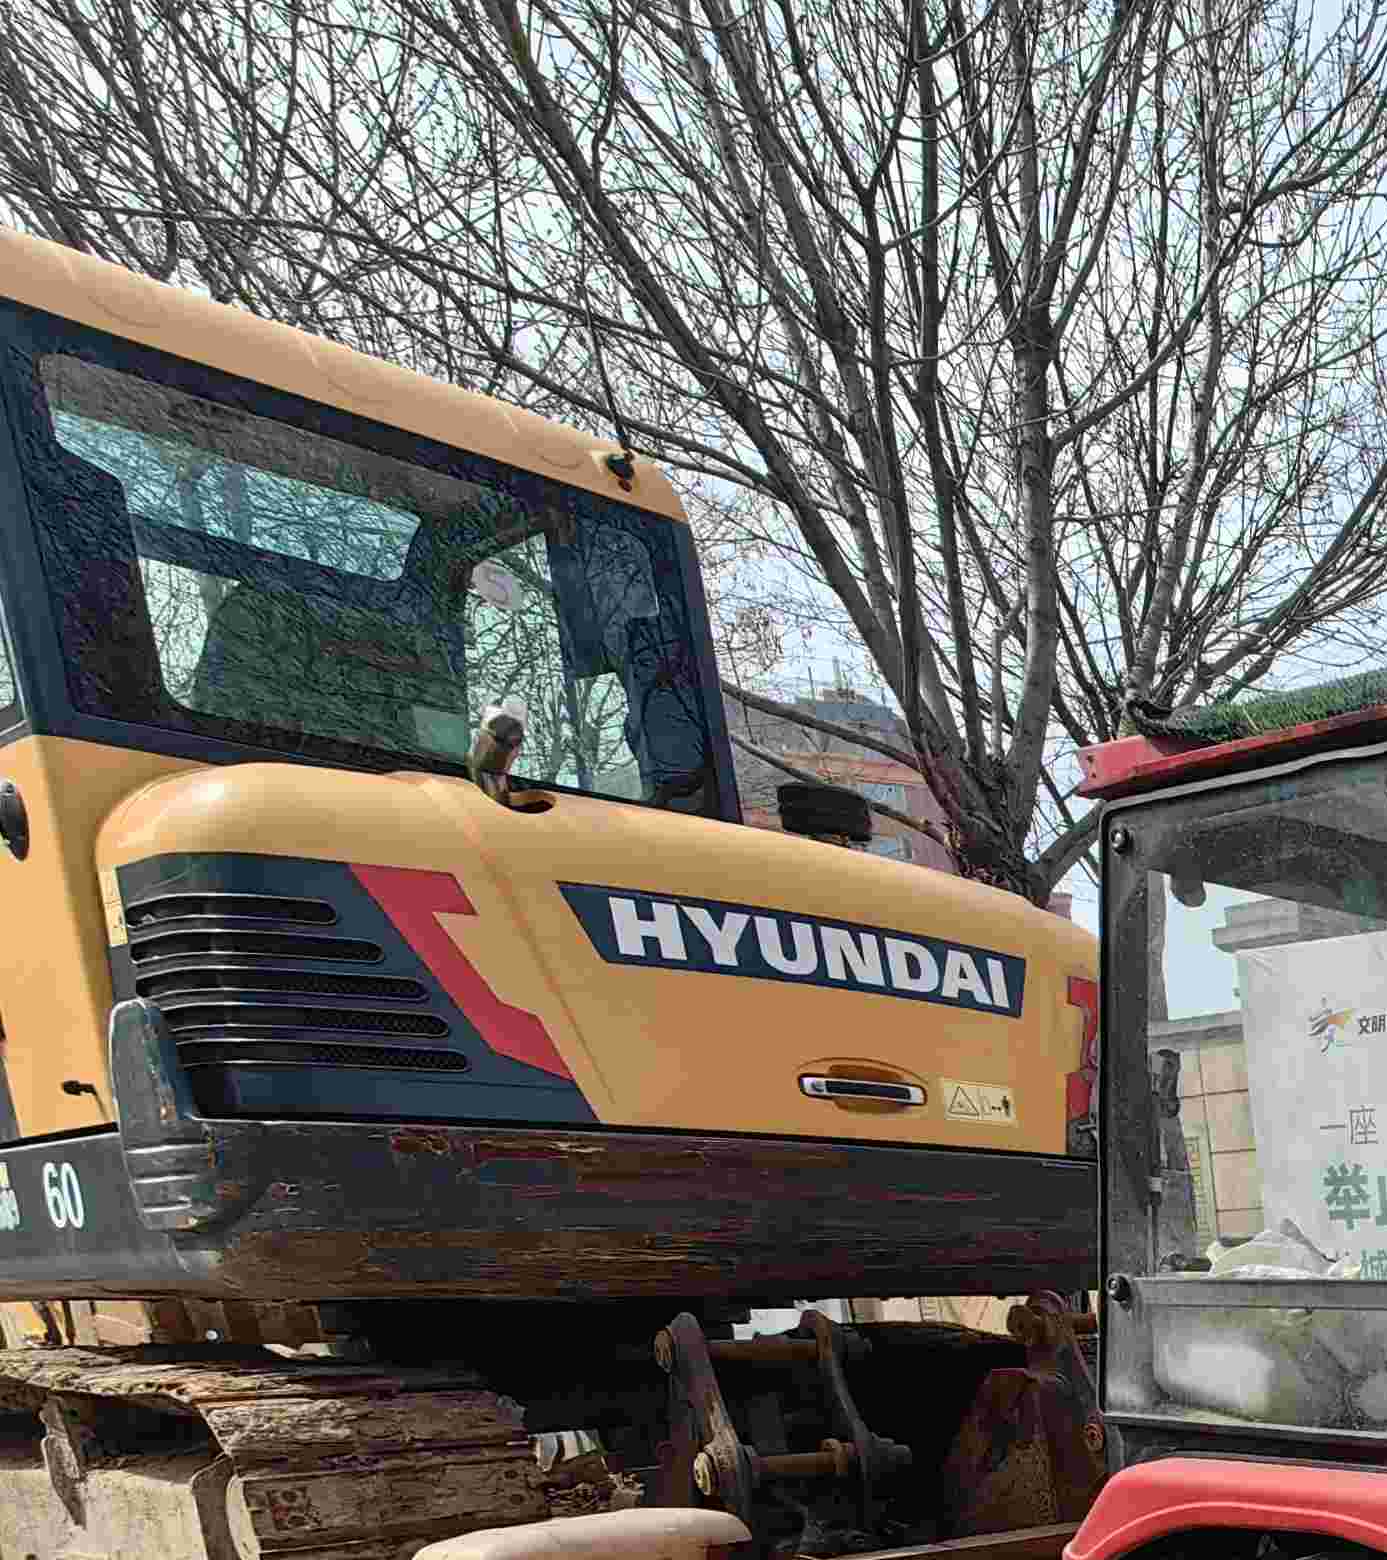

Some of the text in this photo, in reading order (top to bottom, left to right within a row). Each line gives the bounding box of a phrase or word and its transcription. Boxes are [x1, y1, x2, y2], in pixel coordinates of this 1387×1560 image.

[608, 896, 1010, 1009] HYUNDAI
[1319, 1104, 1379, 1144] 一座
[43, 1161, 84, 1229] 60
